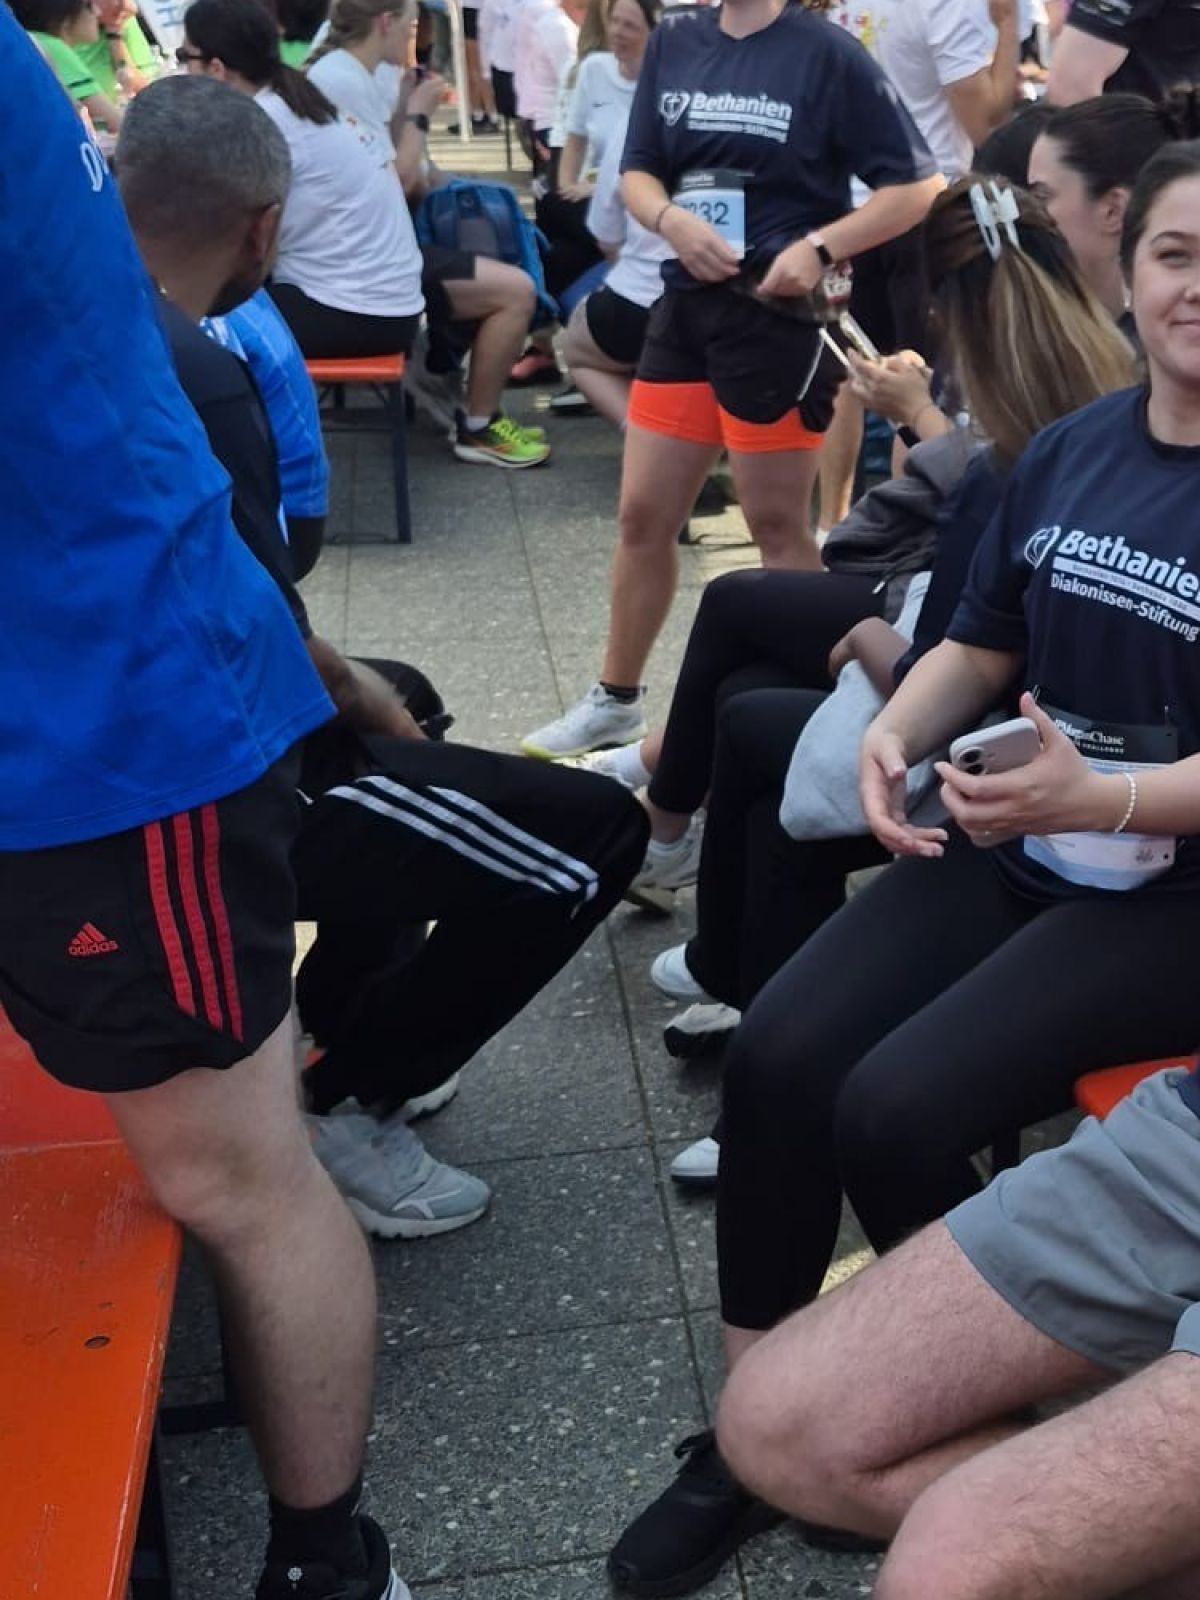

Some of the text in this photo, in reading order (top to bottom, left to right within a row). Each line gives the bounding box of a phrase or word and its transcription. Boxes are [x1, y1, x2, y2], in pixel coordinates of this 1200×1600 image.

[691, 92, 793, 121] Bethanien
[1050, 573, 1200, 642] Diakonissen-Stiftung
[69, 941, 118, 955] adidas
